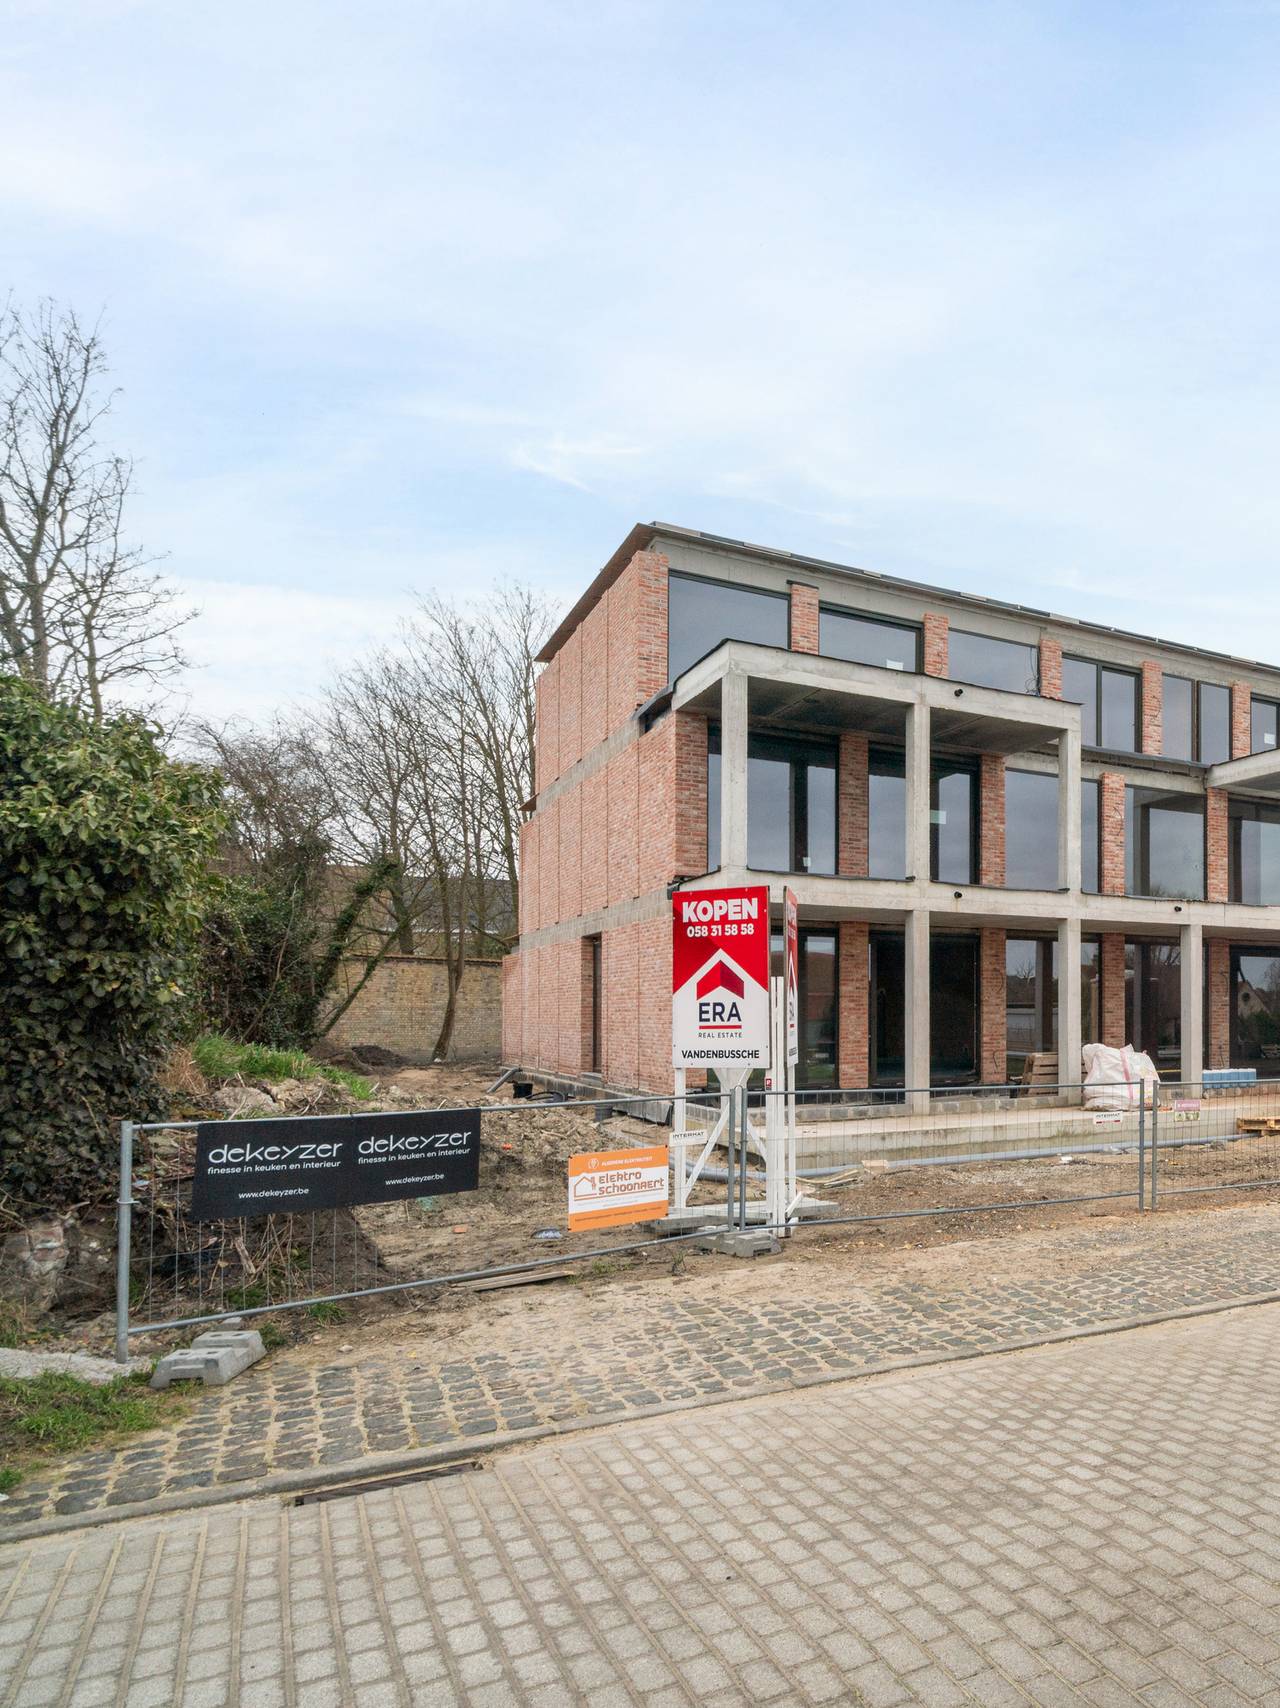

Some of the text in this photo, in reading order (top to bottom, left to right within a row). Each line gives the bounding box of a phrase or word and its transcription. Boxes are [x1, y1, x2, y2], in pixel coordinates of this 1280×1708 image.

[682, 898, 758, 923] KOPEN
[687, 923, 755, 938] 058 31 58 58
[699, 1002, 742, 1022] ERA
[682, 1050, 760, 1059] VANDENBUSSCHE
[358, 1130, 472, 1155] dekeyzer
[208, 1141, 343, 1164] dekeyzer
[358, 1147, 471, 1165] finesse in keuken en interieur
[207, 1159, 342, 1175] finesse in keuken en interieur
[385, 1173, 445, 1186] www.dekeyzer.be
[238, 1187, 310, 1199] www.dekeyzer.be
